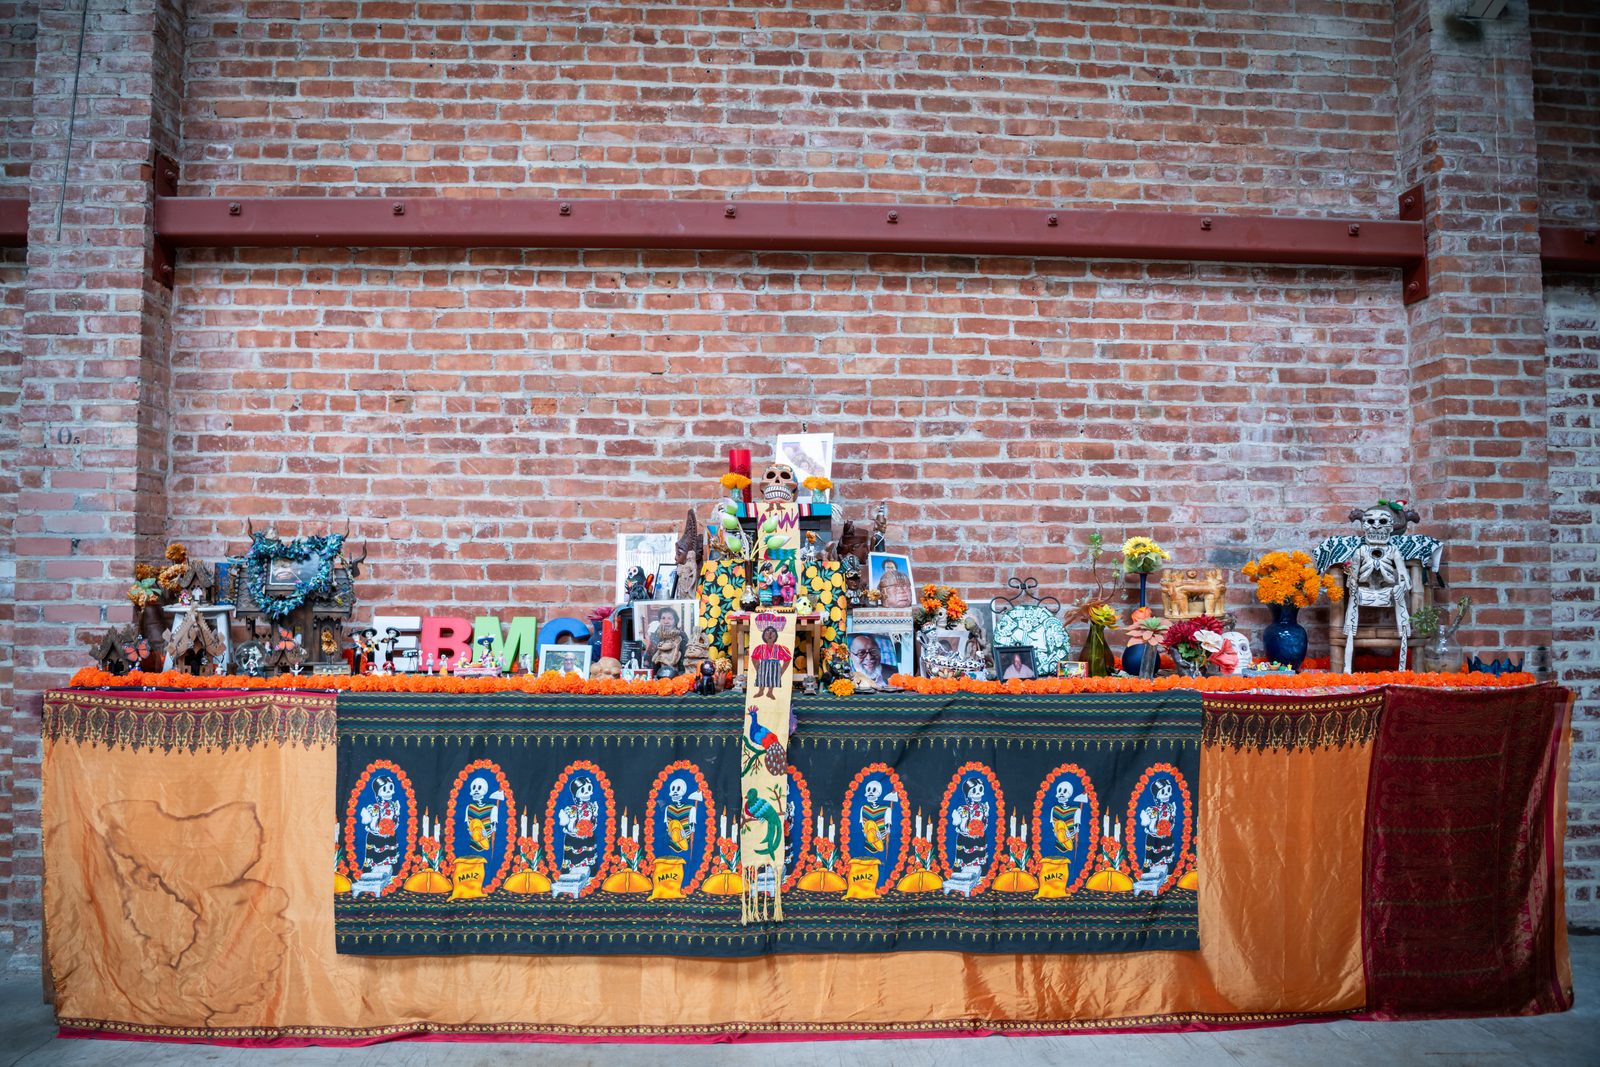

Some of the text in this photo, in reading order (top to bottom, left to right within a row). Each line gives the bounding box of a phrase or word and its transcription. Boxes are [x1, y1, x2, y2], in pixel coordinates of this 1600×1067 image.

[458, 872, 479, 882] MAIZ
[658, 872, 678, 882] MAIZ
[852, 873, 873, 882] MAIZ
[1044, 872, 1063, 882] MAIZ
